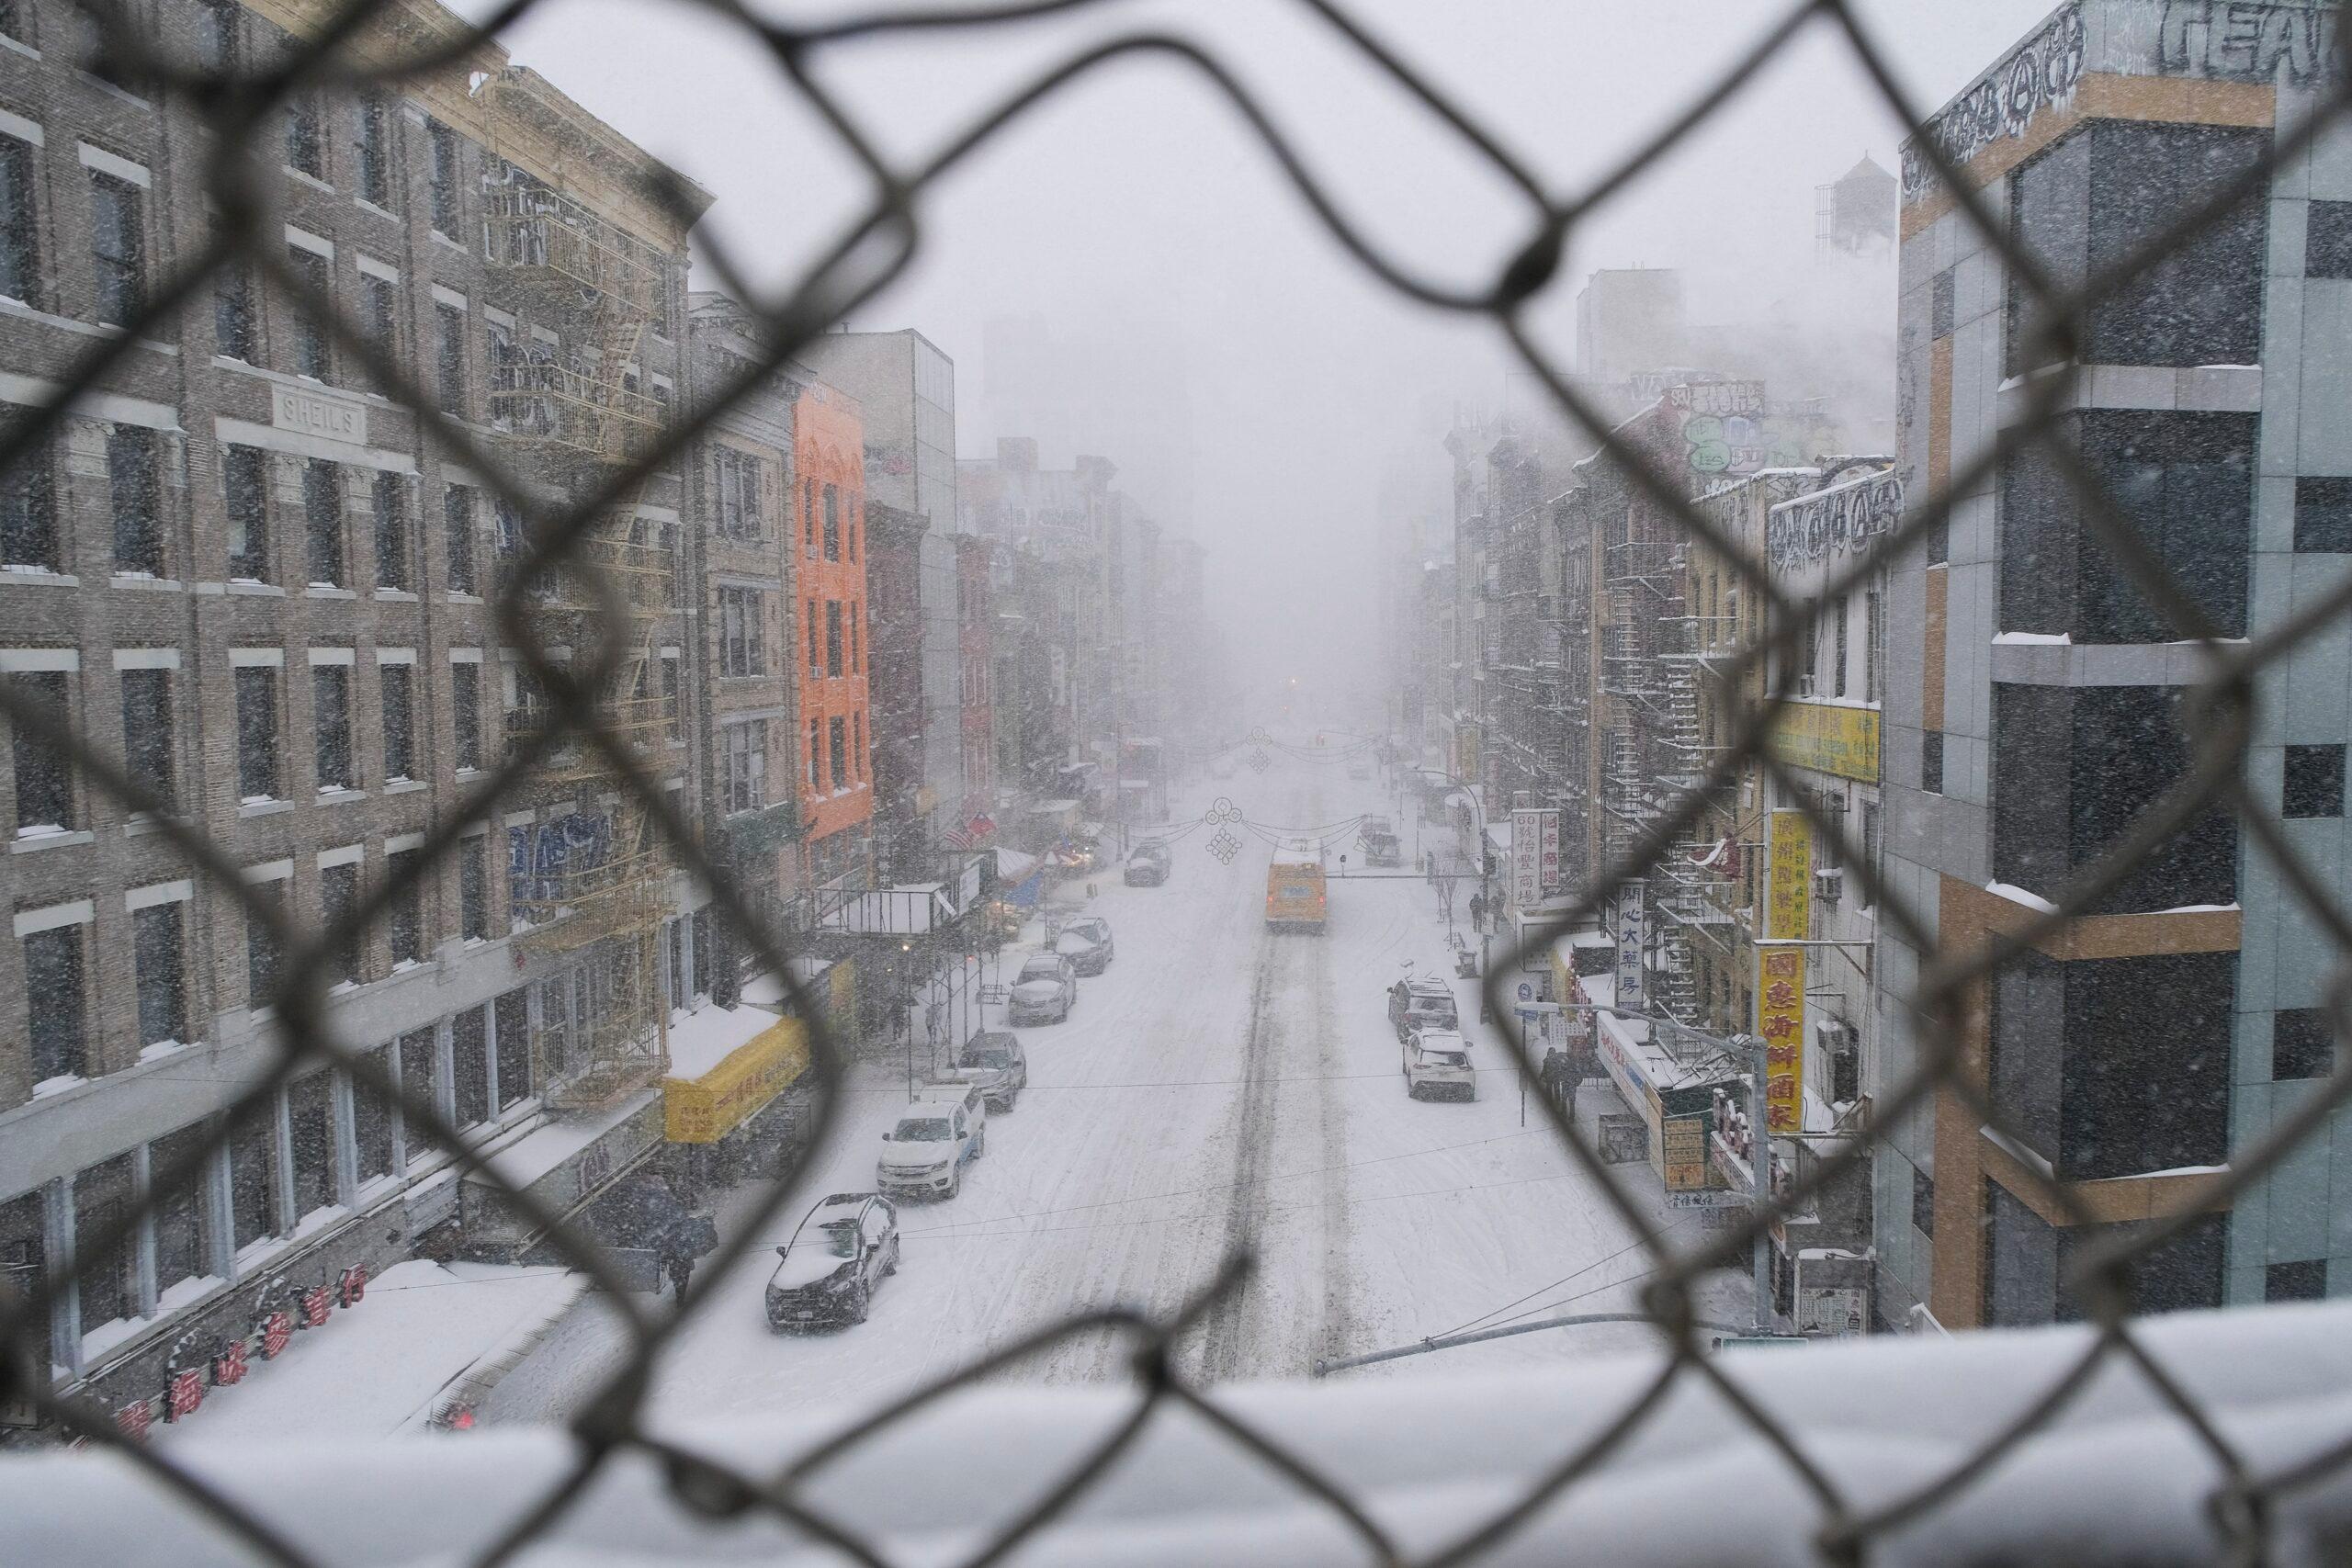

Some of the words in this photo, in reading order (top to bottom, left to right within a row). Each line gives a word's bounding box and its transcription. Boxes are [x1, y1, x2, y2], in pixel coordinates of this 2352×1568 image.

[283, 397, 353, 434] SHEILS
[1621, 886, 1642, 996] 開心大藥房
